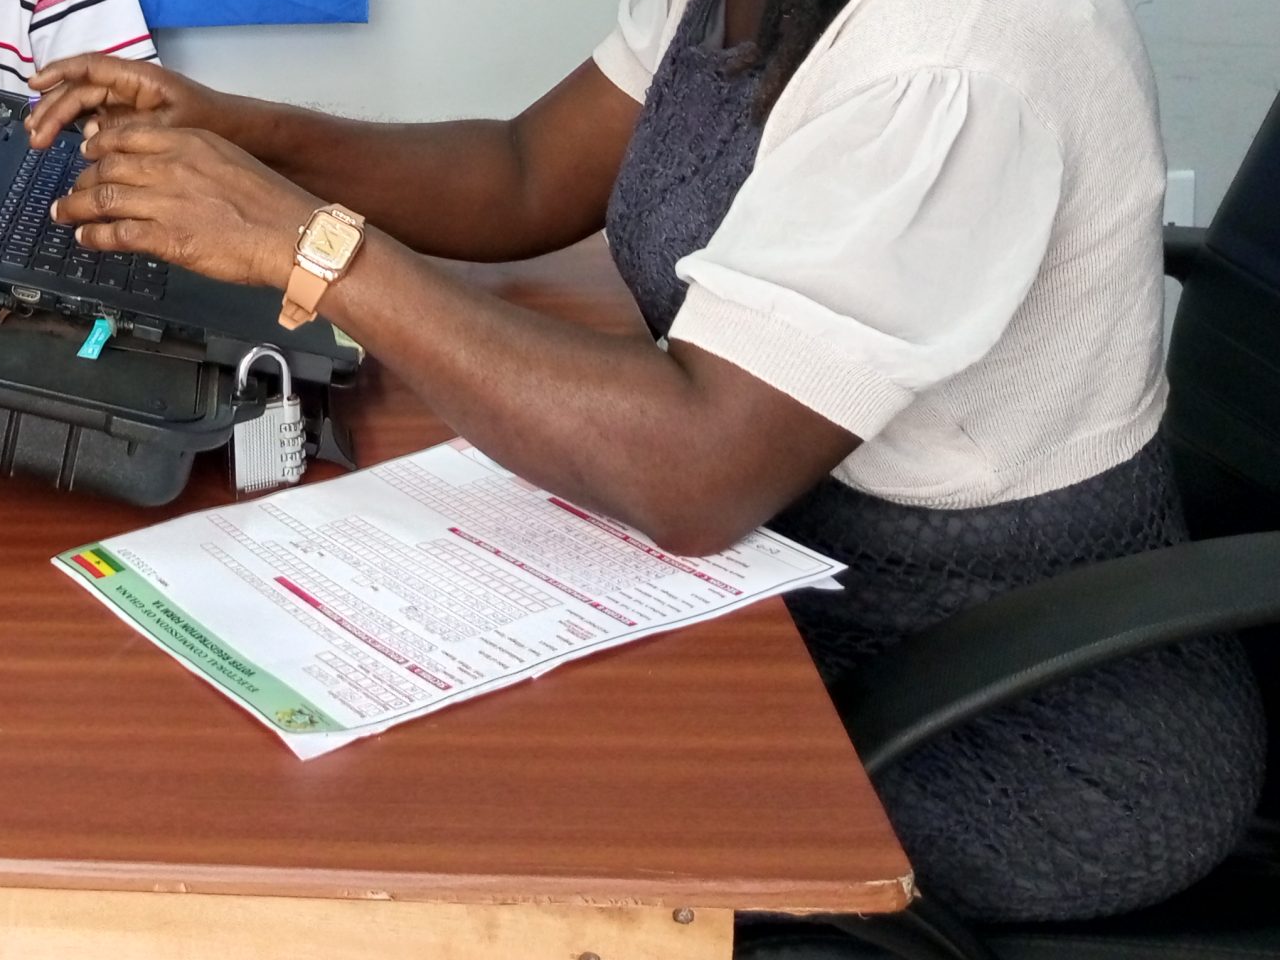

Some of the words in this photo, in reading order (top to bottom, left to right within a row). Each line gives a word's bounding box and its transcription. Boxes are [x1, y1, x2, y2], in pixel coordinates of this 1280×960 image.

[116, 585, 144, 610] GHANA
[143, 608, 157, 619] OF
[163, 608, 185, 625] FORM
[155, 618, 209, 660] COMMISSION
[181, 622, 233, 661] REGISTRATION
[207, 657, 260, 693] ELECTORAL
[229, 660, 257, 677] VOTER
